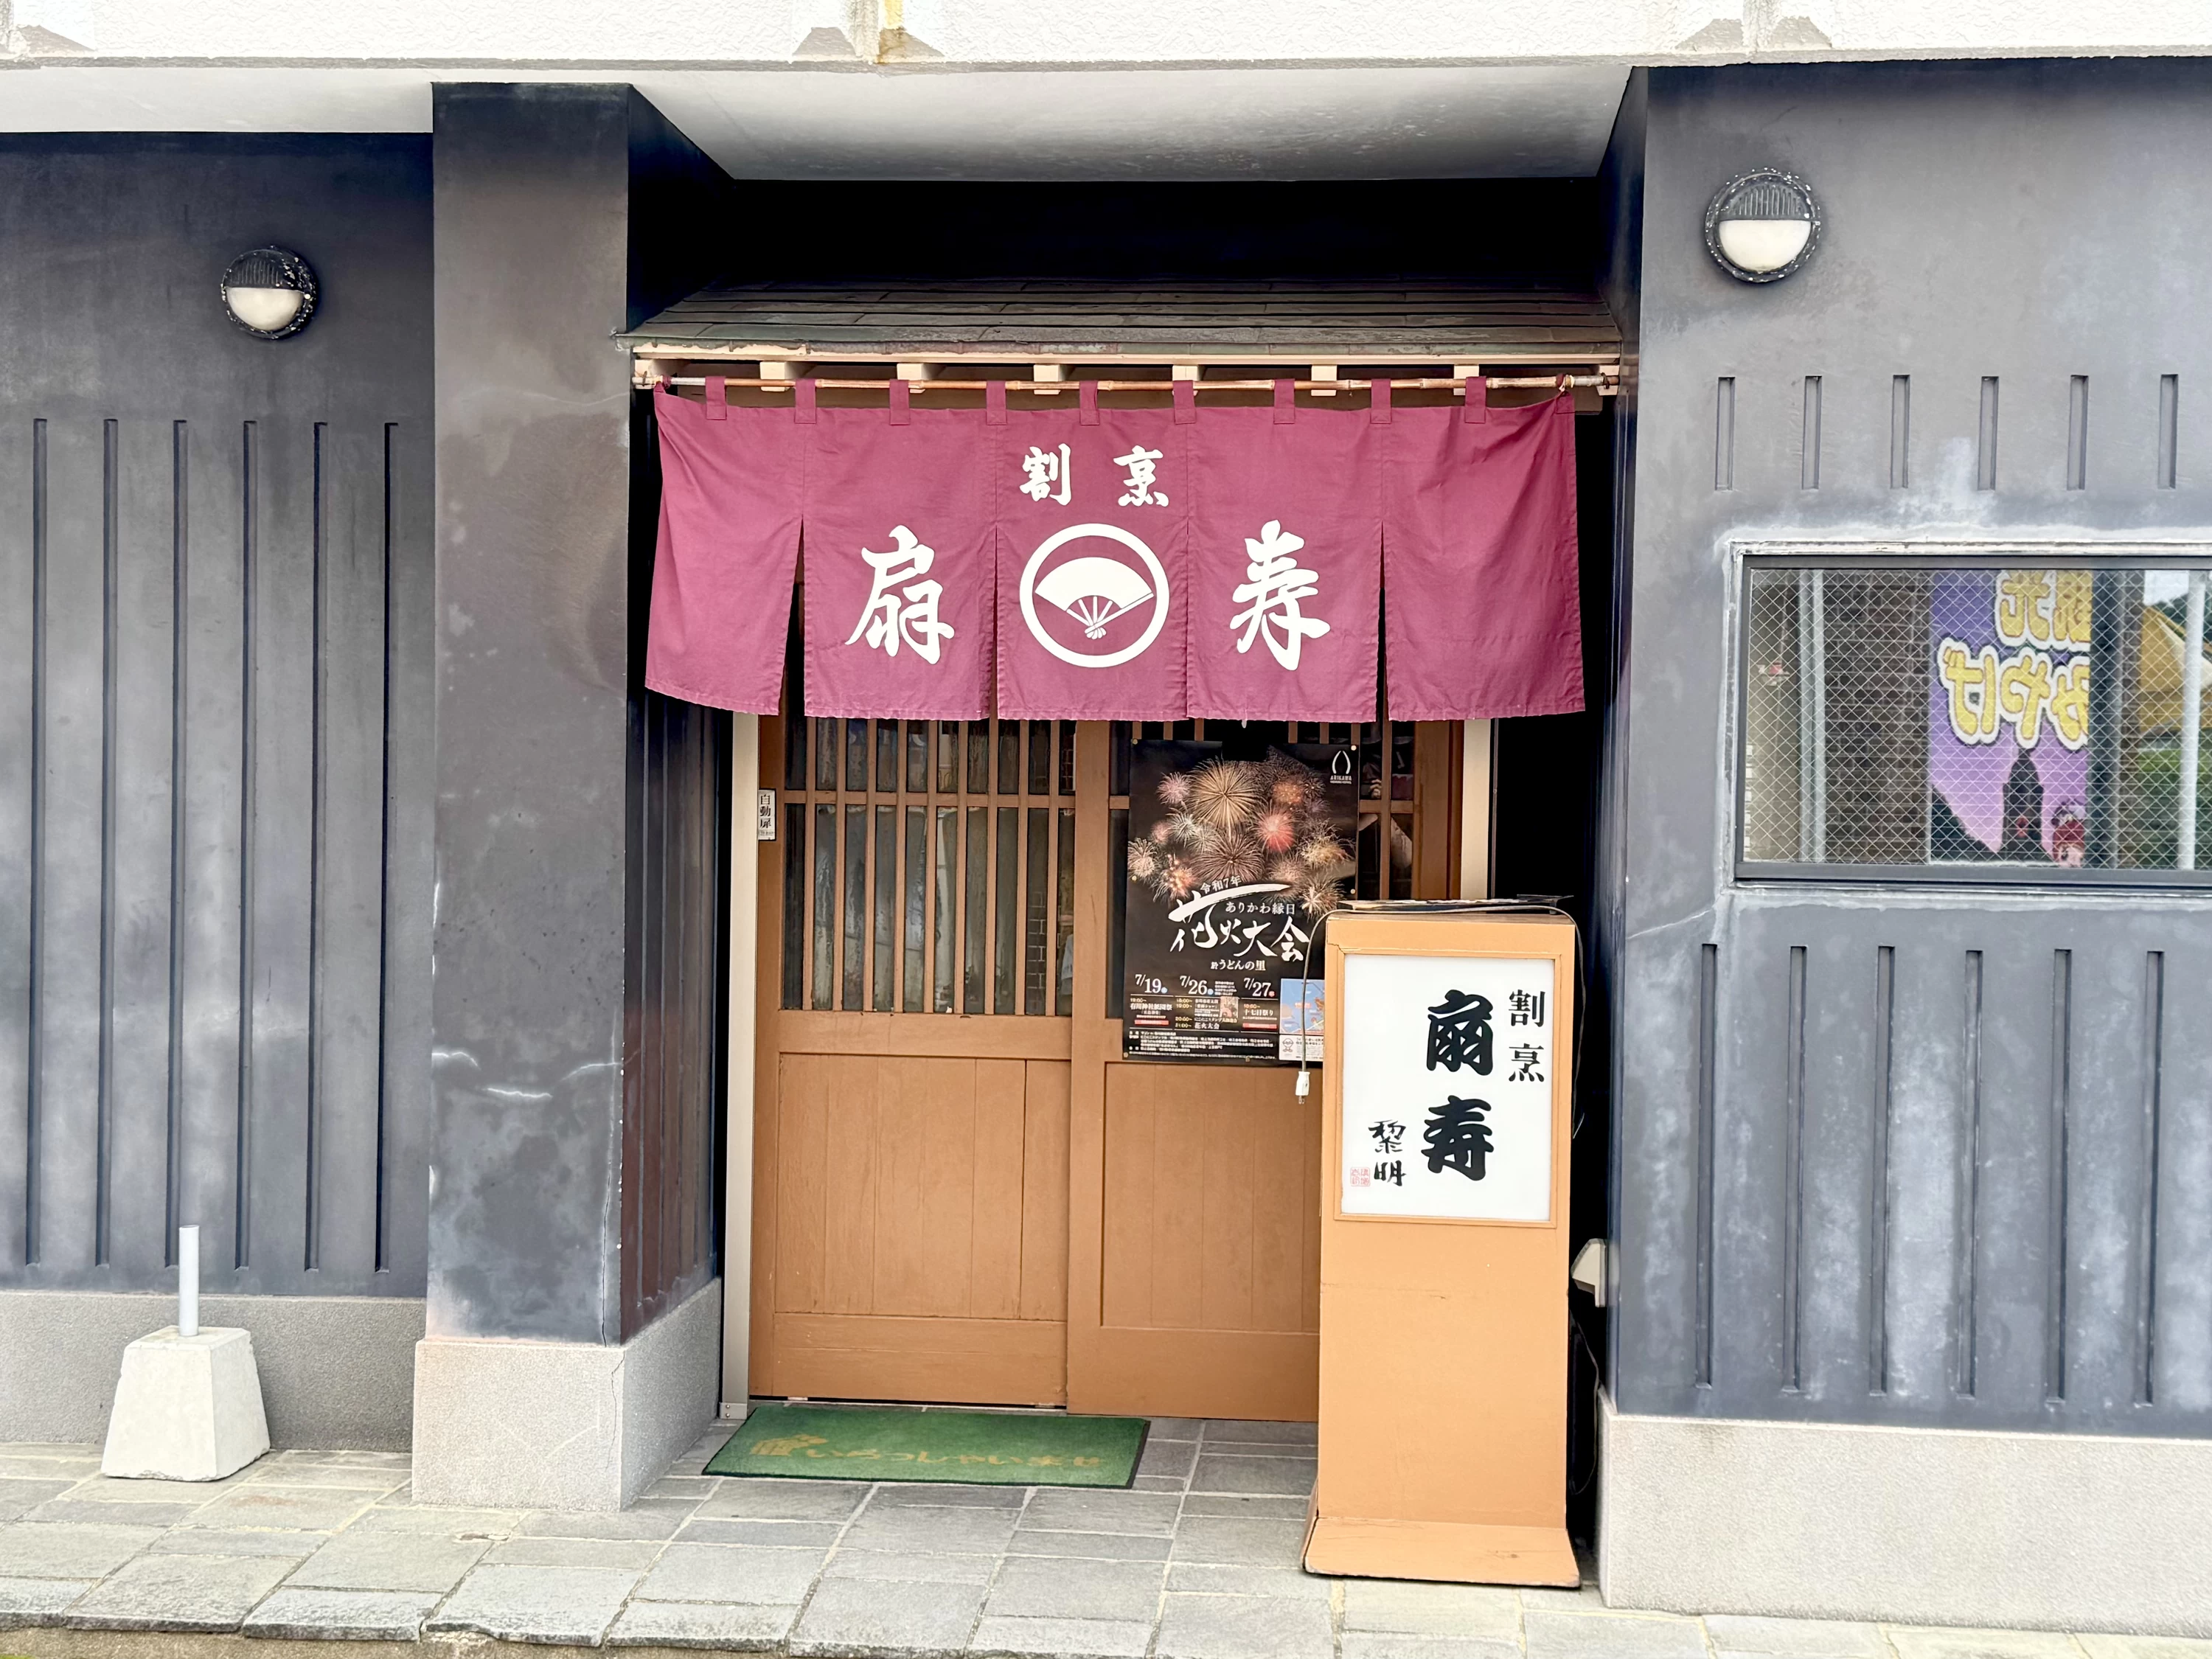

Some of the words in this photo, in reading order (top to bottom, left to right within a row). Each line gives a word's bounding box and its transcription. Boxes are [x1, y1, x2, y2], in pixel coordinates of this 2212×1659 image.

[1020, 443, 1169, 507] 割烹
[844, 524, 955, 665] 扇
[1229, 519, 1331, 671] 寿
[759, 794, 771, 829] 自動扉
[1200, 875, 1242, 894] 令和7年
[1225, 901, 1295, 915] ありかわ縁日
[1168, 884, 1310, 962] 花火大会
[1135, 974, 1162, 994] 7/19
[1180, 975, 1208, 995] 7/26
[1243, 977, 1272, 997] 7/27
[1509, 990, 1545, 1082] 割烹
